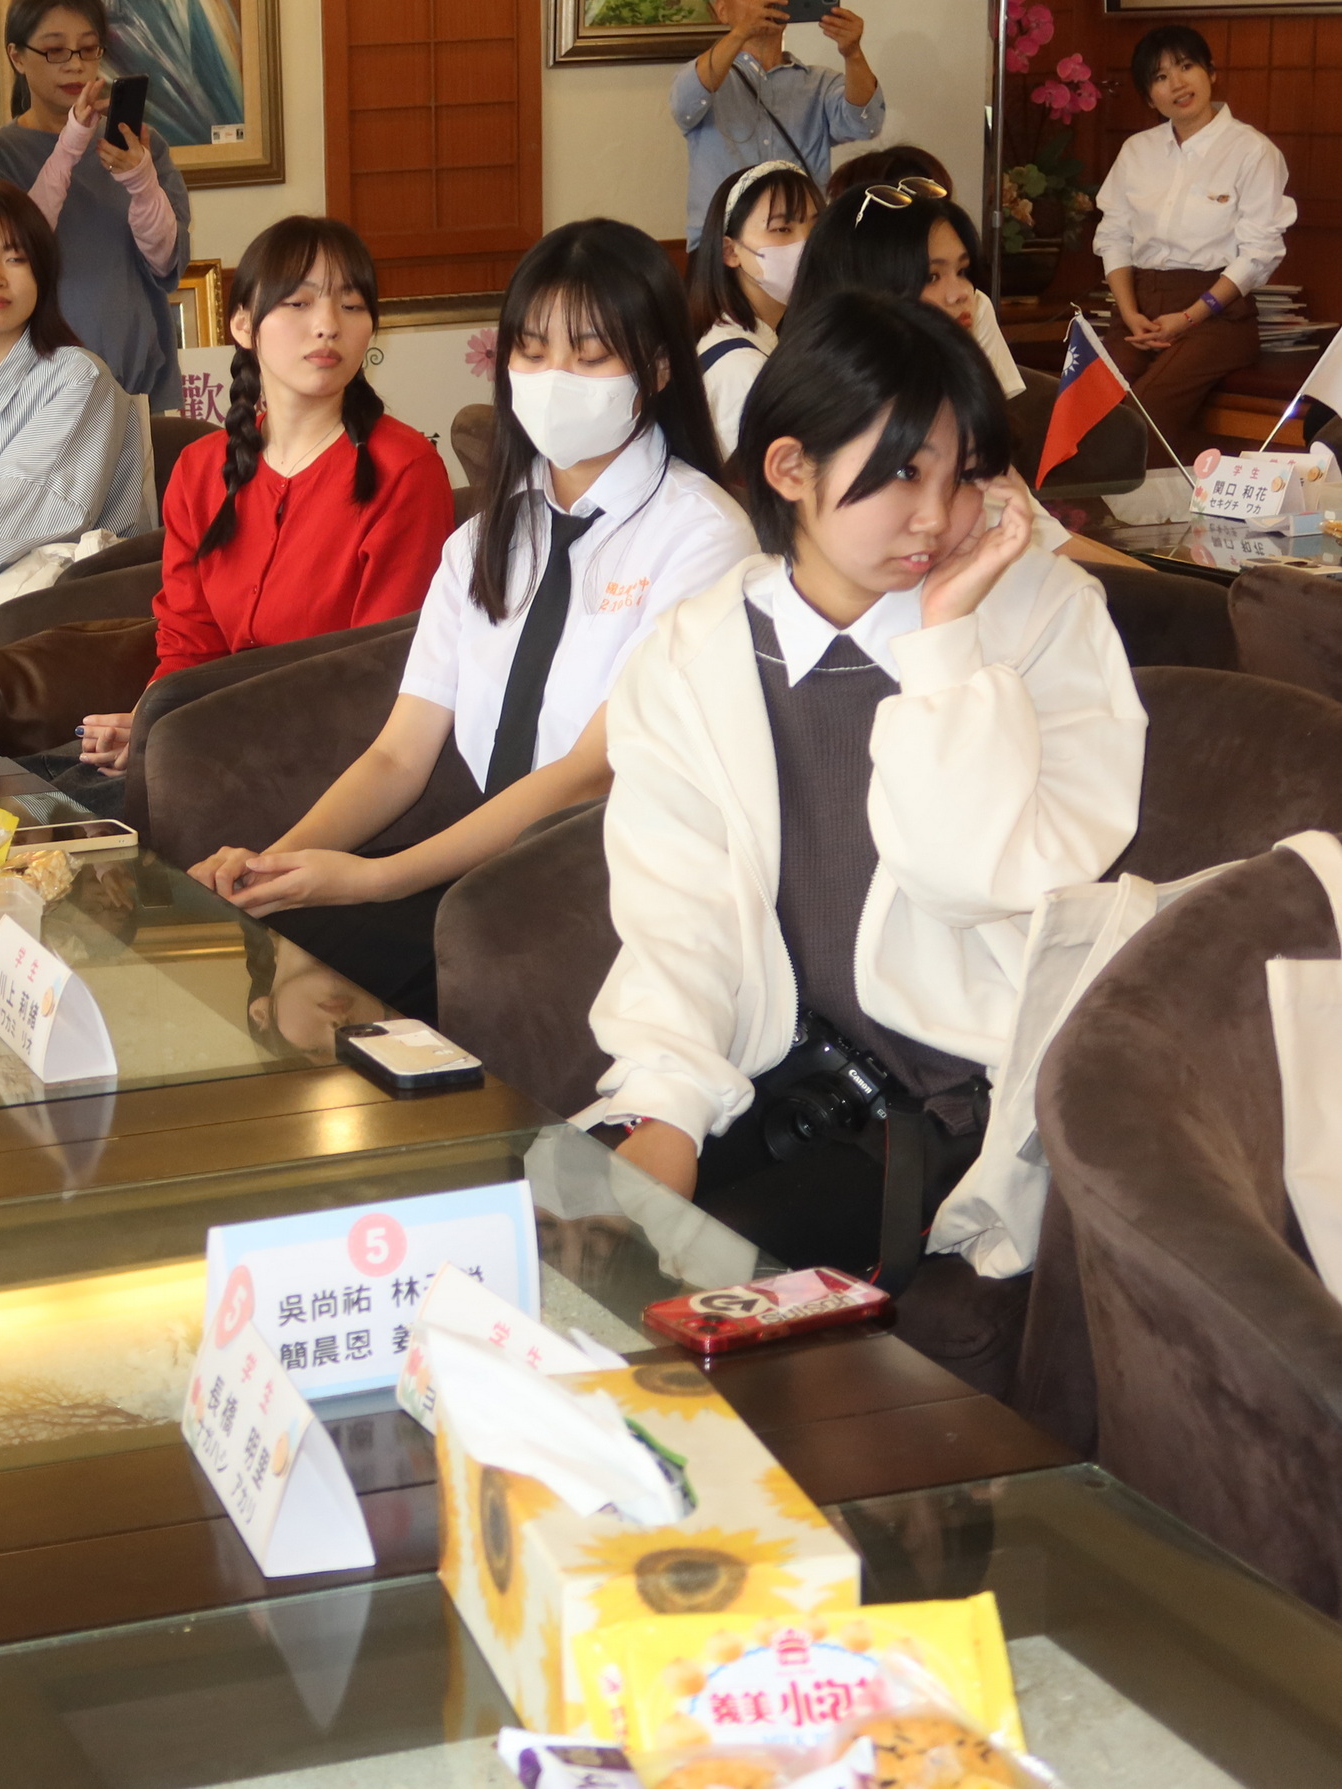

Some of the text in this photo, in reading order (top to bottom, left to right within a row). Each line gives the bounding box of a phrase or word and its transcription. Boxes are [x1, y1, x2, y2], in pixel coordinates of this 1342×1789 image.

[1203, 456, 1213, 473] 1
[1209, 498, 1262, 515] セキグチ ワカ
[1212, 480, 1268, 502] 関口 和花
[848, 1068, 873, 1095] Canon
[365, 1226, 390, 1265] 5
[224, 1285, 248, 1333] 5
[278, 1283, 373, 1327] 吳尚祐
[279, 1328, 375, 1373] 簡晨恩
[208, 1374, 238, 1439] 長橋
